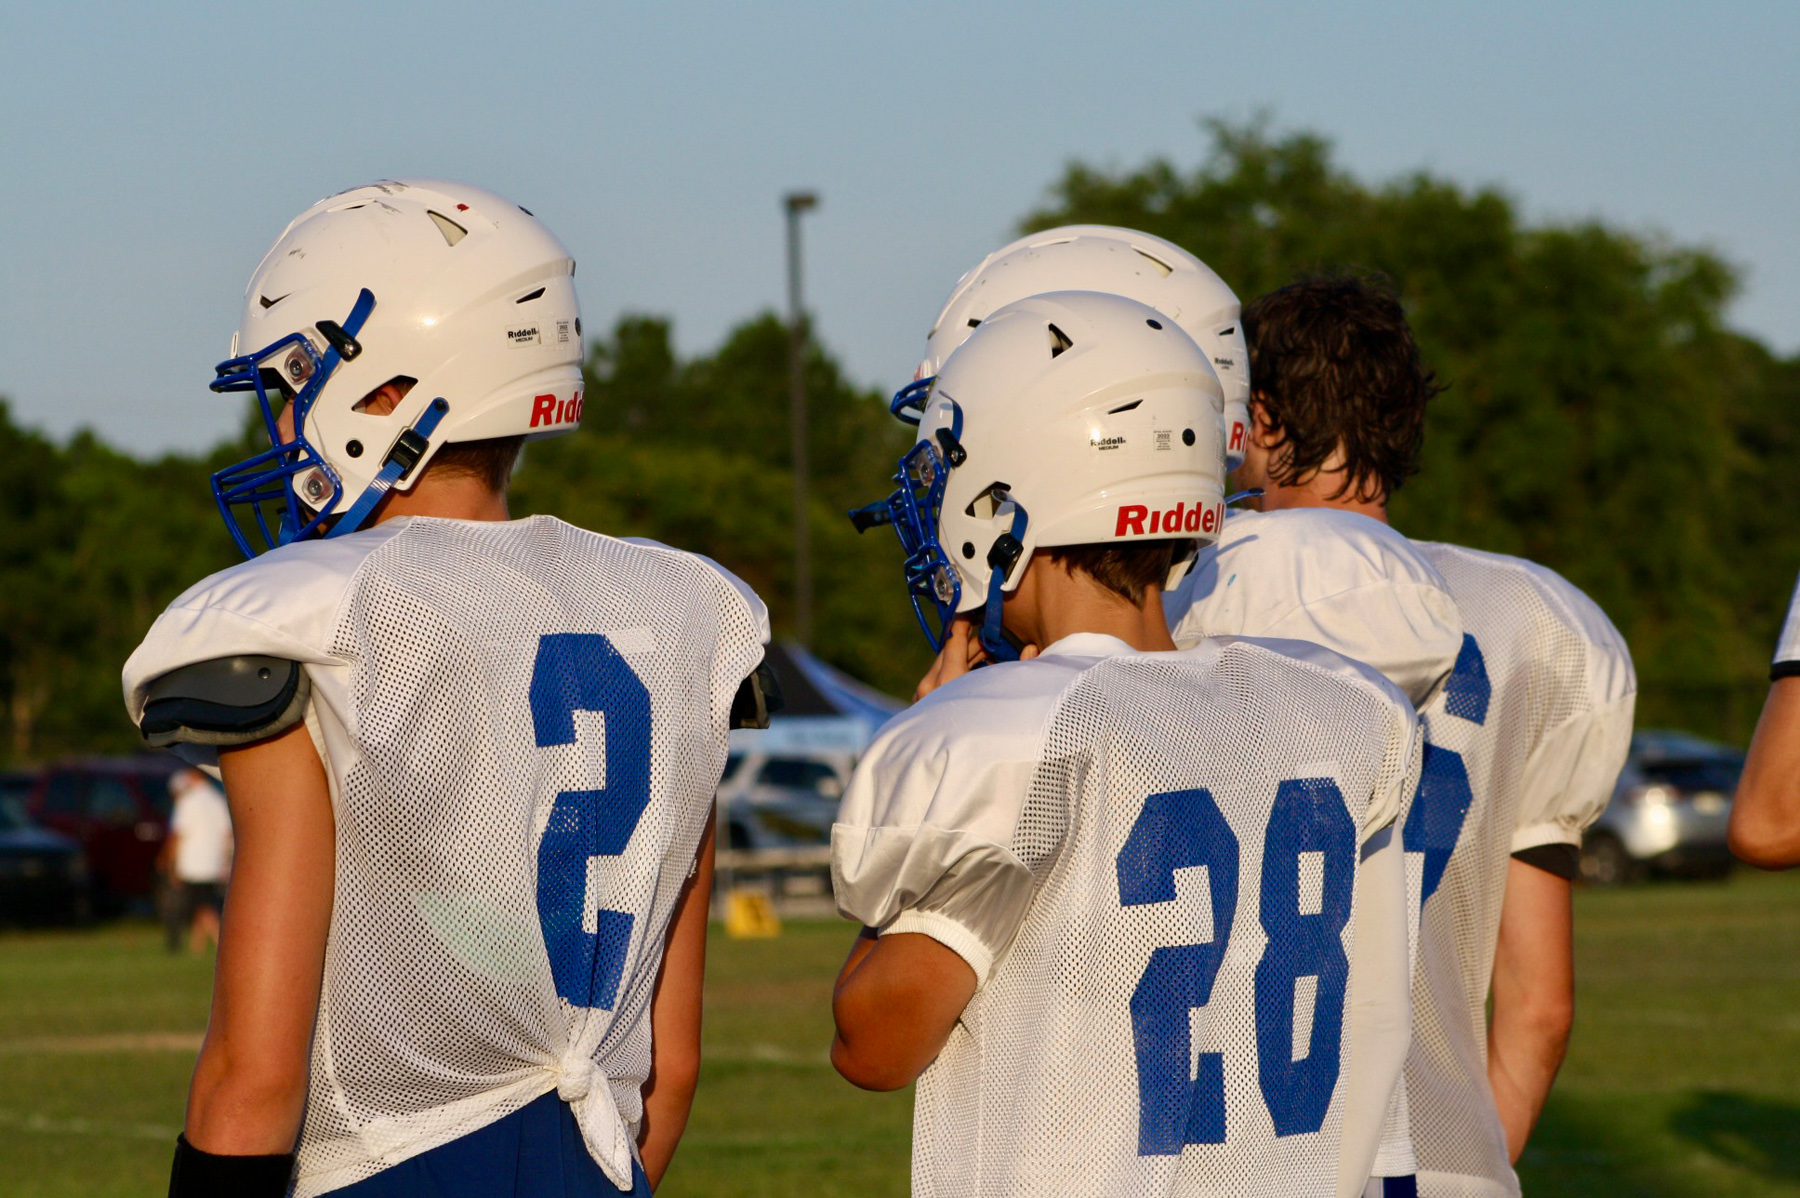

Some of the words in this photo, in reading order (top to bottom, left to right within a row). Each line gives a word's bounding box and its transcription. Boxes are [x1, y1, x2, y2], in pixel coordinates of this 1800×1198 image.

[507, 328, 537, 338] Riddell
[1090, 436, 1126, 447] Rddell
[1114, 501, 1225, 537] Riddell
[529, 633, 652, 1010] 2
[1116, 777, 1357, 1157] 28
